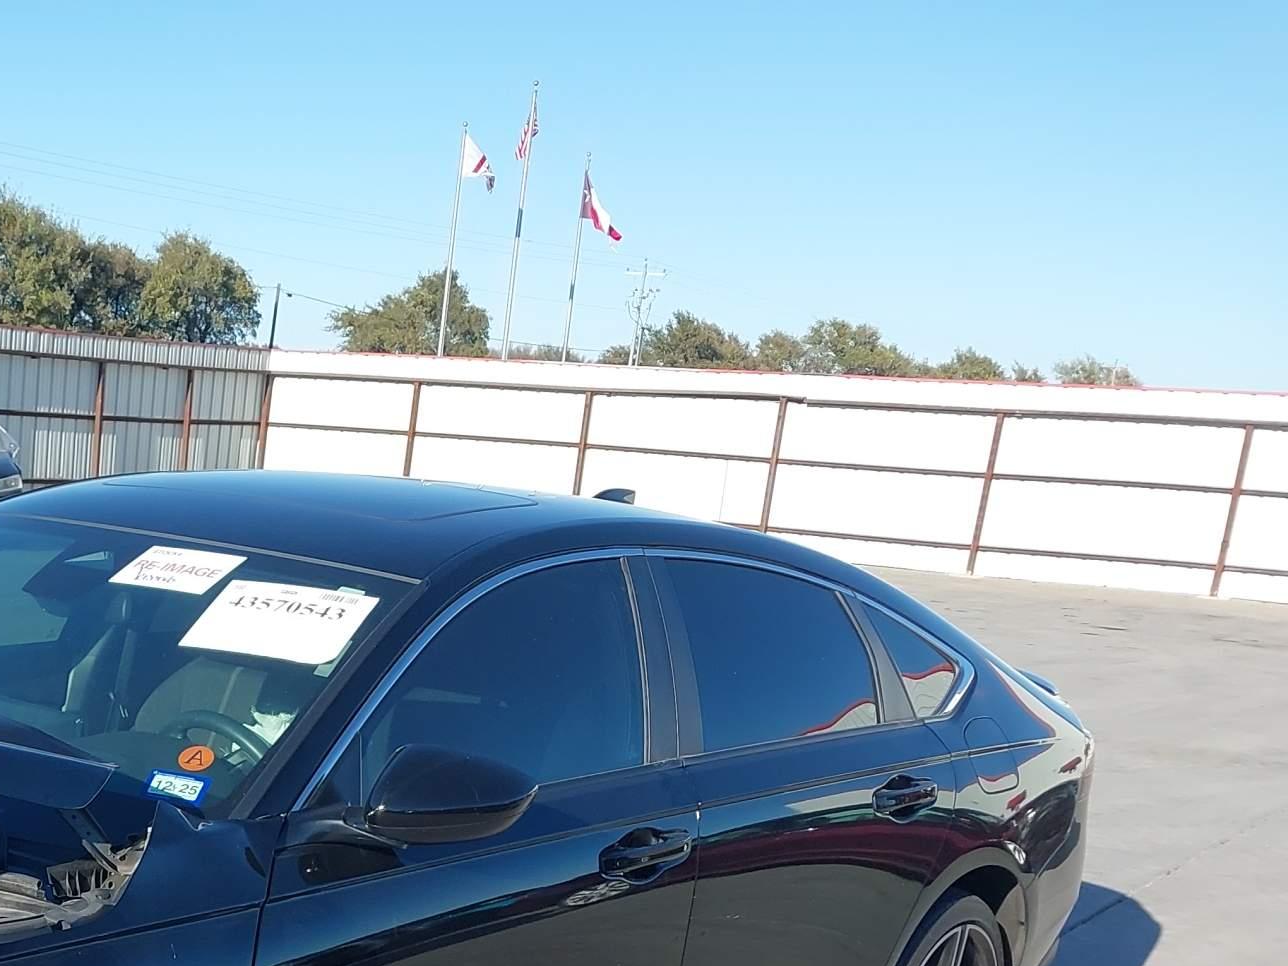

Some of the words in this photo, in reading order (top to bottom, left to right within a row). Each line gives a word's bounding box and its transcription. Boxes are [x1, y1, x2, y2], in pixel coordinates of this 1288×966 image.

[134, 559, 223, 579] RE-IMAGE
[229, 595, 347, 620] 43570543
[184, 749, 205, 767] A
[178, 783, 200, 796] 25
